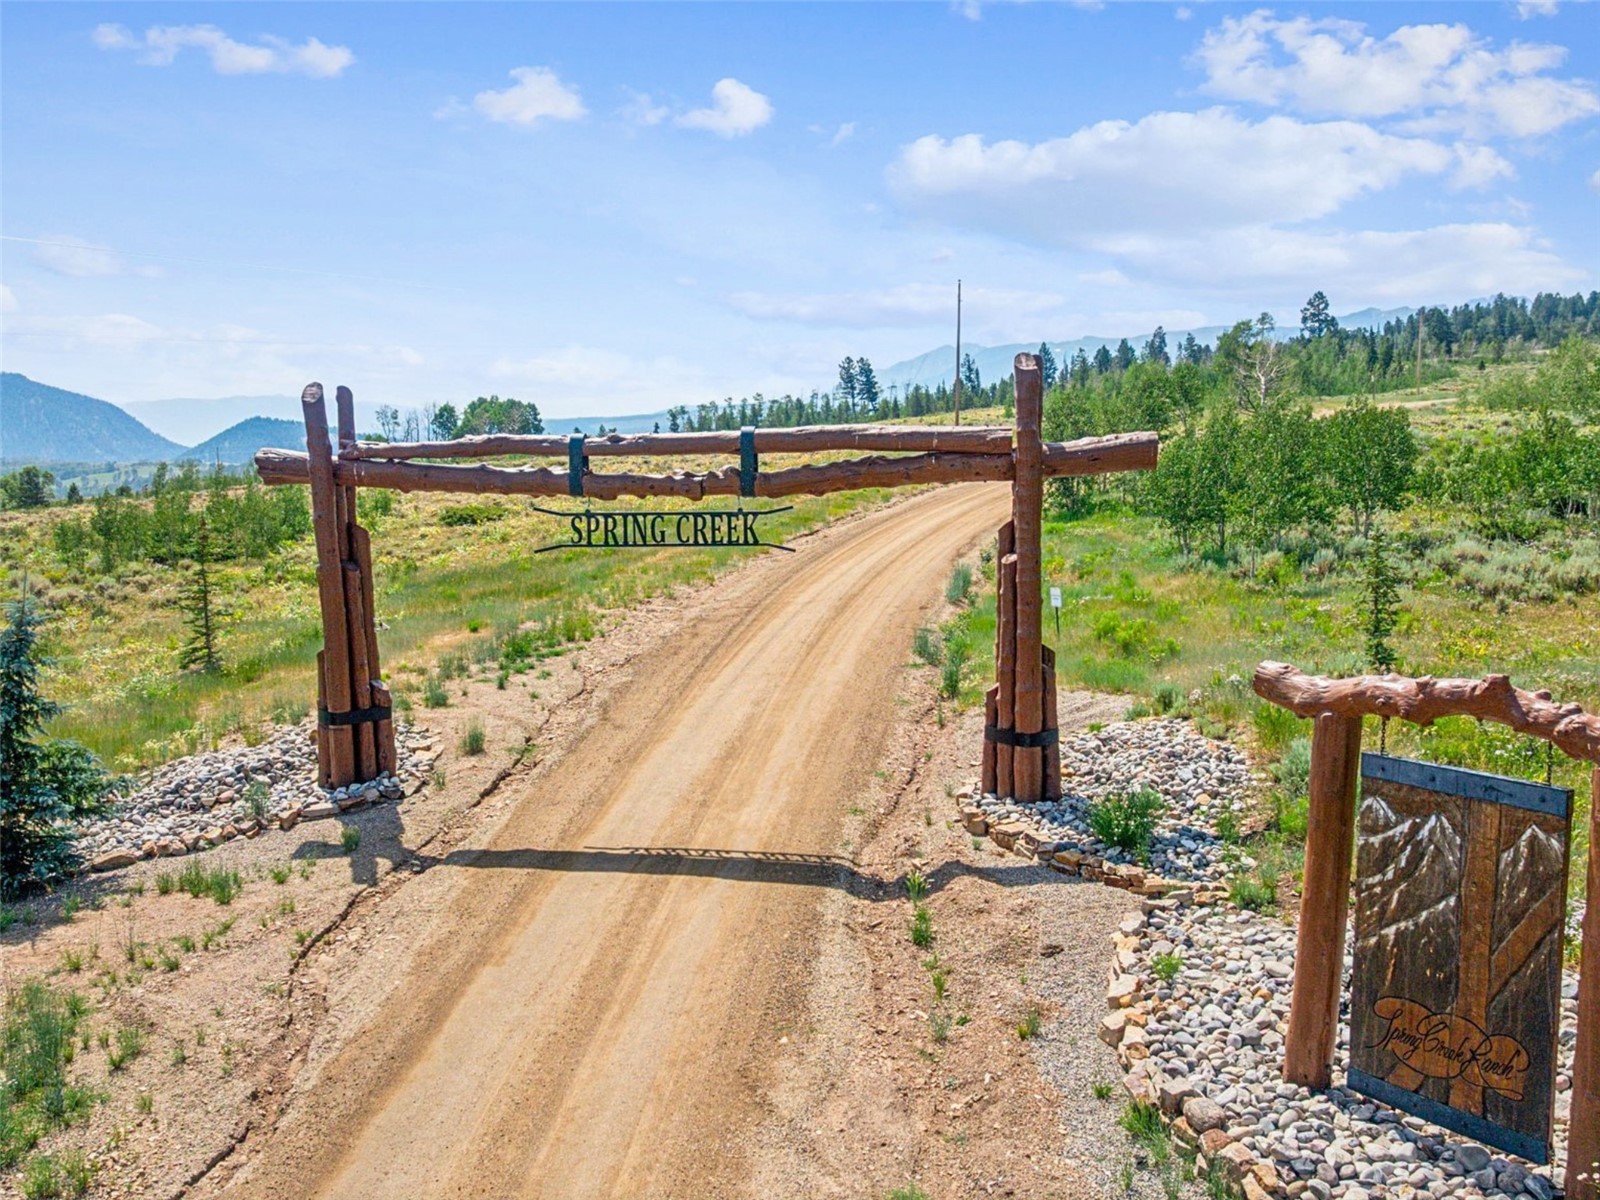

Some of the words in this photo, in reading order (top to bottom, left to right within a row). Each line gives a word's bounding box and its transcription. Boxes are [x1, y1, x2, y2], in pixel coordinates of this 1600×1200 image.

[570, 513, 666, 546] SPRING
[676, 512, 760, 545] CREEK
[1366, 1003, 1424, 1060] Spring
[1418, 1014, 1466, 1065] Creek
[1463, 1034, 1524, 1086] Ranch
